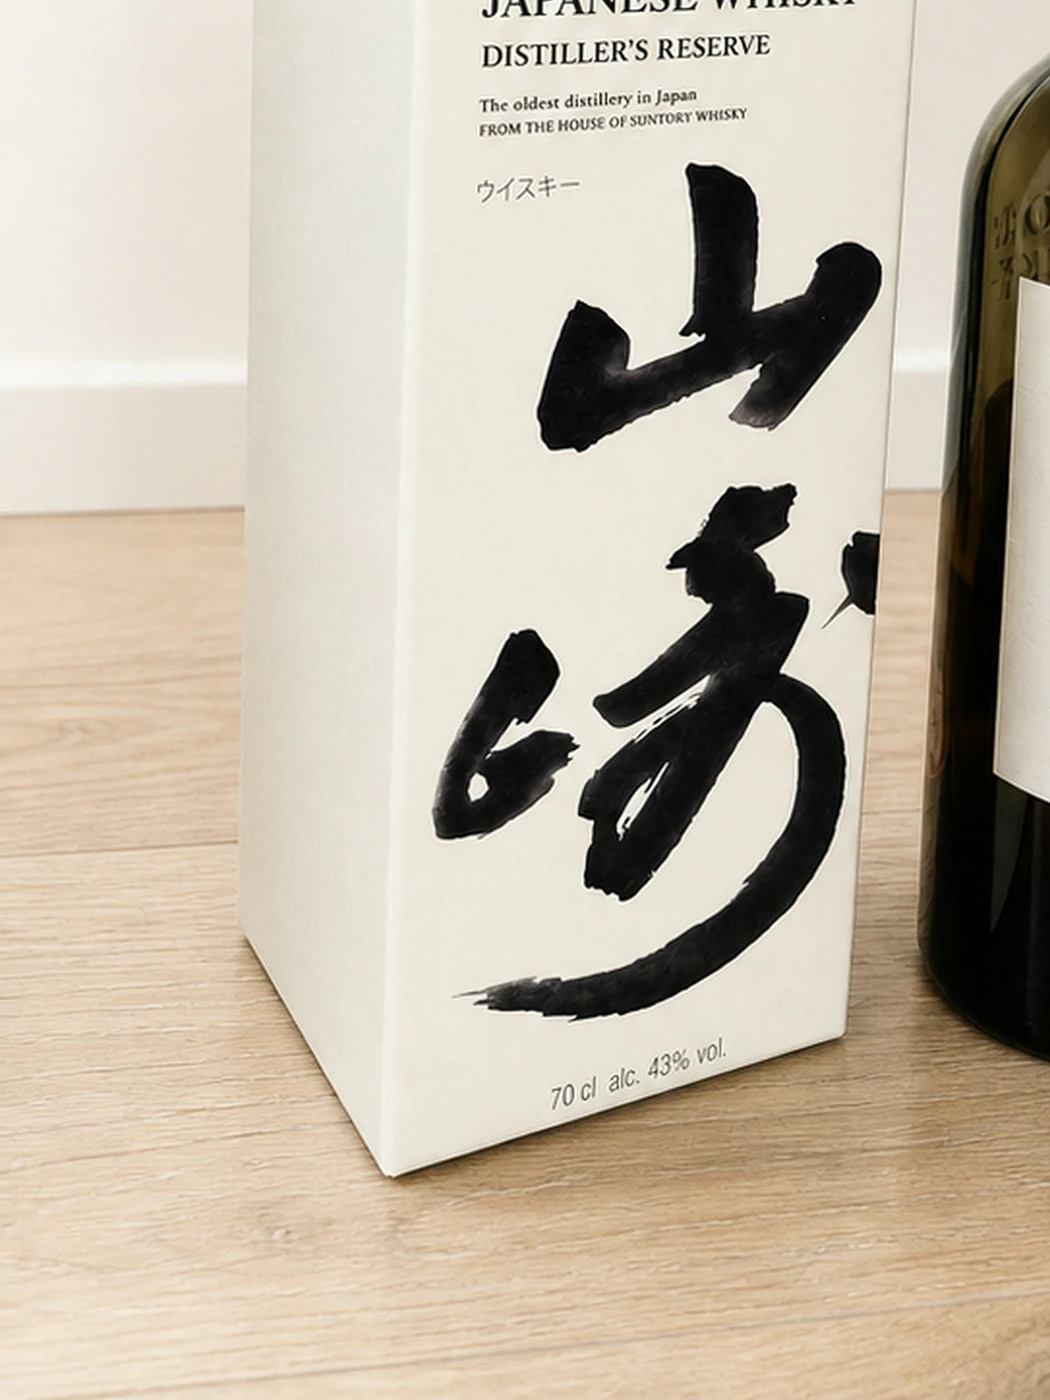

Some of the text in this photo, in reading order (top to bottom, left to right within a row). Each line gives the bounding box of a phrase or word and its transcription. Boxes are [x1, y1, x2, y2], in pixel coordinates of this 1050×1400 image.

[482, 34, 771, 68] DISTILLER’S RESERVE
[479, 89, 698, 113] The oldest distillery in Japan
[479, 107, 748, 137] FROM THE HOUSE OF SUNTORY WHISKY
[476, 175, 580, 204] ウイスキー
[551, 1037, 727, 1111] 70 cl alc. 43% vol.
